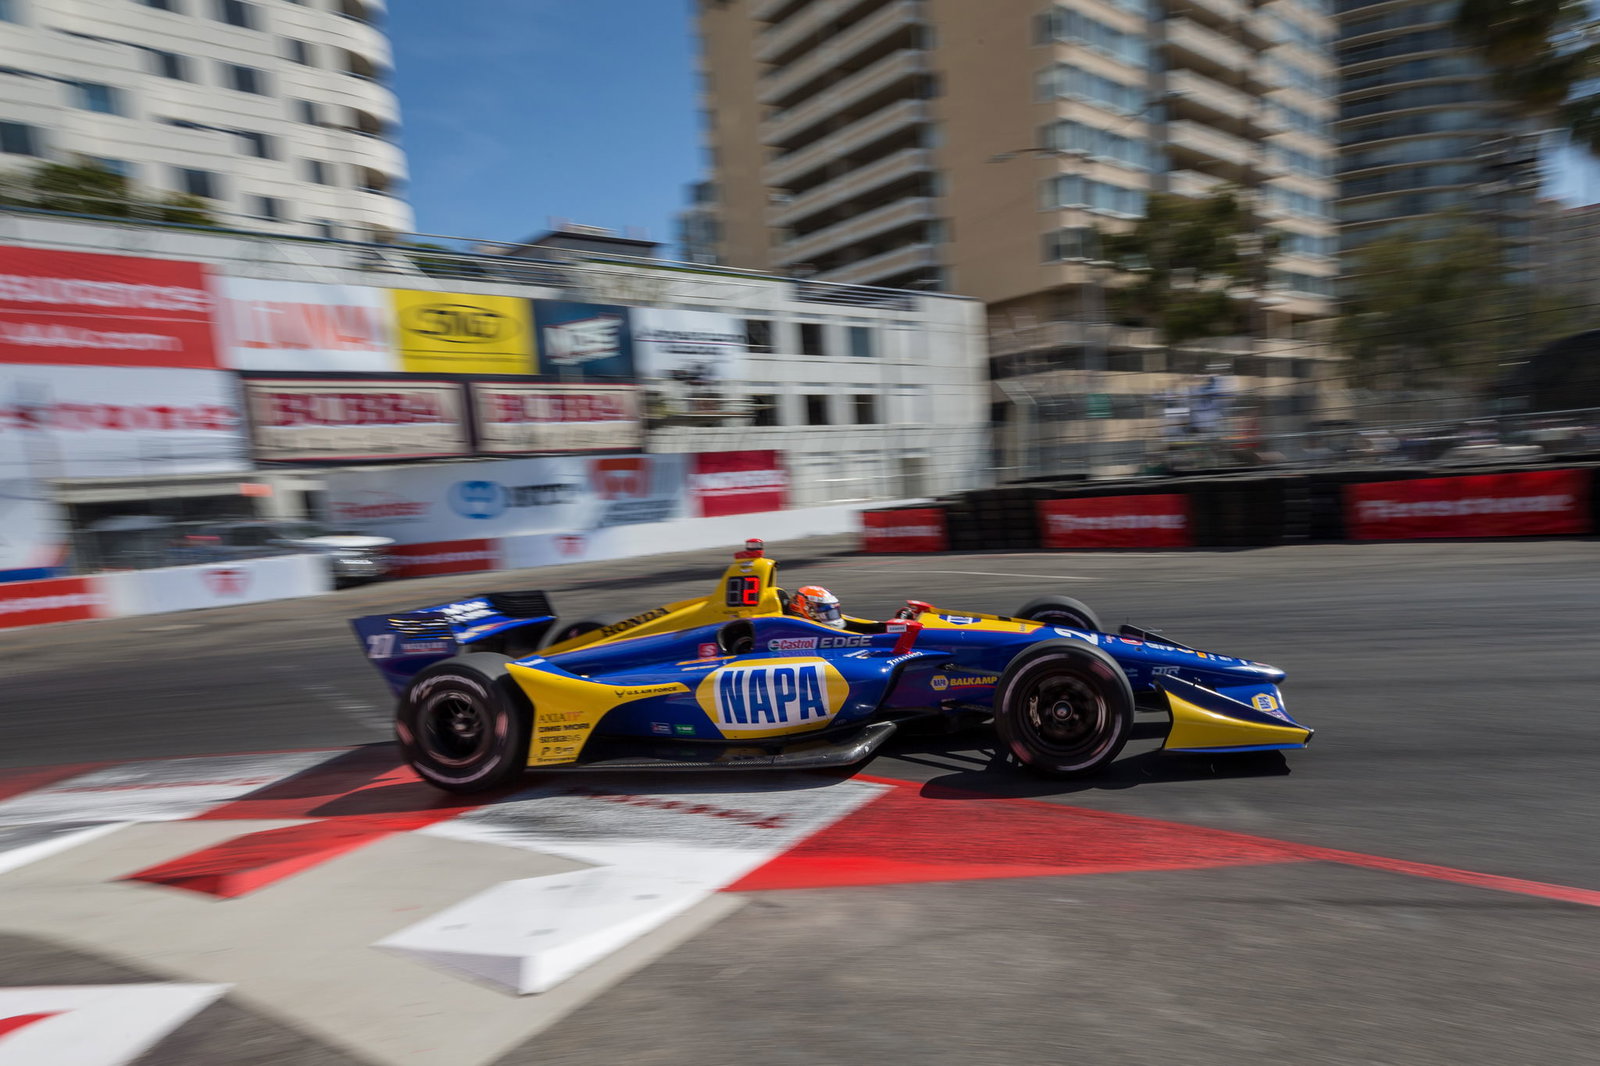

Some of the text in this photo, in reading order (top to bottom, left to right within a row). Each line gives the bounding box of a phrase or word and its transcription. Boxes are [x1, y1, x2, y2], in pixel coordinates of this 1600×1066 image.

[600, 607, 671, 638] HONDA
[778, 636, 873, 650] Castrol EDGE
[950, 676, 998, 686] BALKAMP
[719, 665, 827, 725] NAPA
